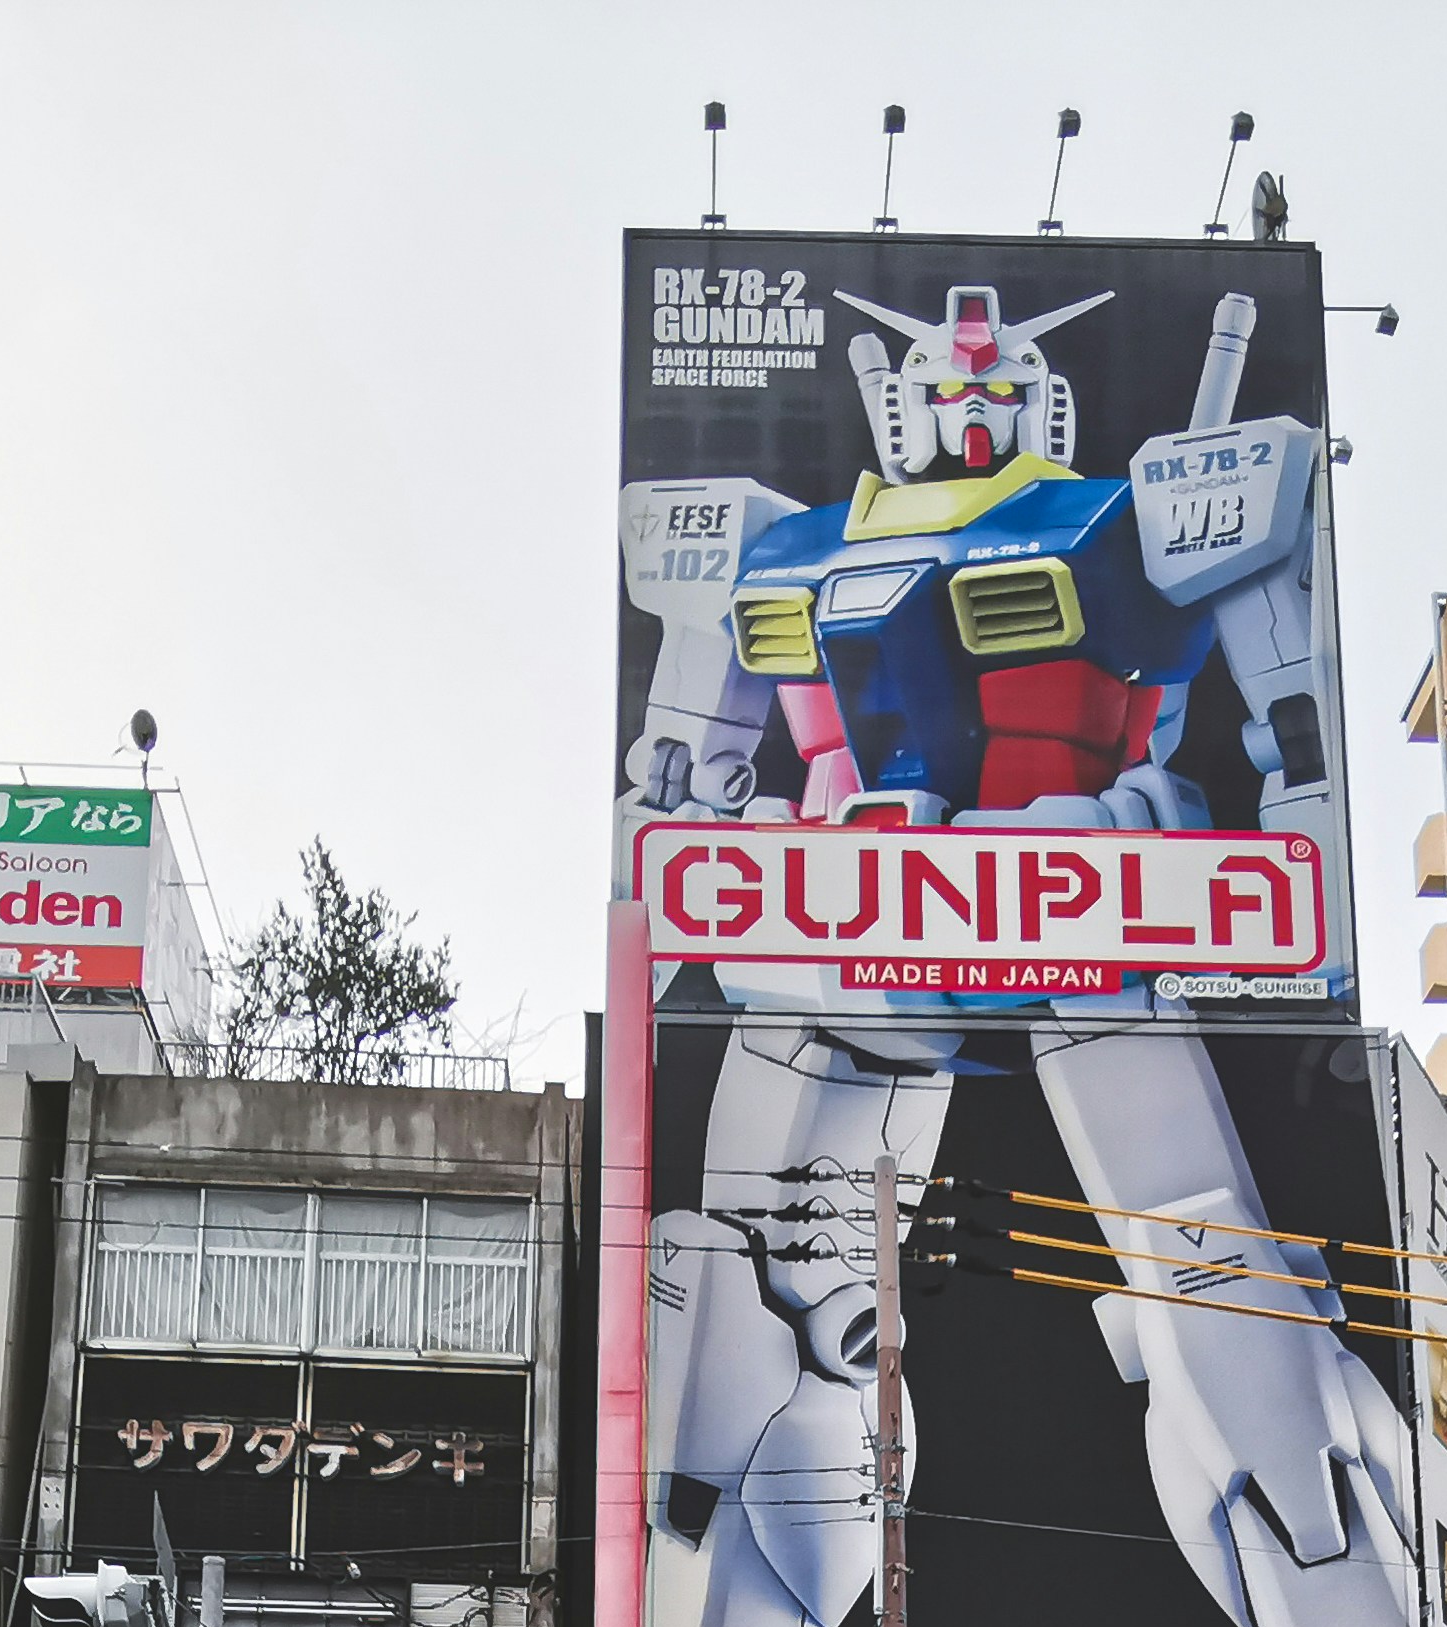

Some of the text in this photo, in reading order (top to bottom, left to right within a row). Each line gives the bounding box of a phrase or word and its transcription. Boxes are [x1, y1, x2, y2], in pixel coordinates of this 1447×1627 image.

[654, 267, 806, 307] RX-78-2
[653, 306, 825, 346] GUNDAM
[652, 347, 817, 370] EARTH FEDERATION
[651, 367, 768, 388] SPACE FORCE
[1142, 441, 1274, 485] RX-78-2
[667, 503, 732, 532] EFSF
[1168, 494, 1245, 547] WB
[661, 549, 730, 582] 102
[662, 845, 1295, 947] GUNPLA
[853, 962, 1103, 989] MADE IN JAPAN
[1183, 979, 1239, 996] SOTSU
[1253, 981, 1323, 997] SUNRISE
[117, 1417, 485, 1487] サワダデンキ
